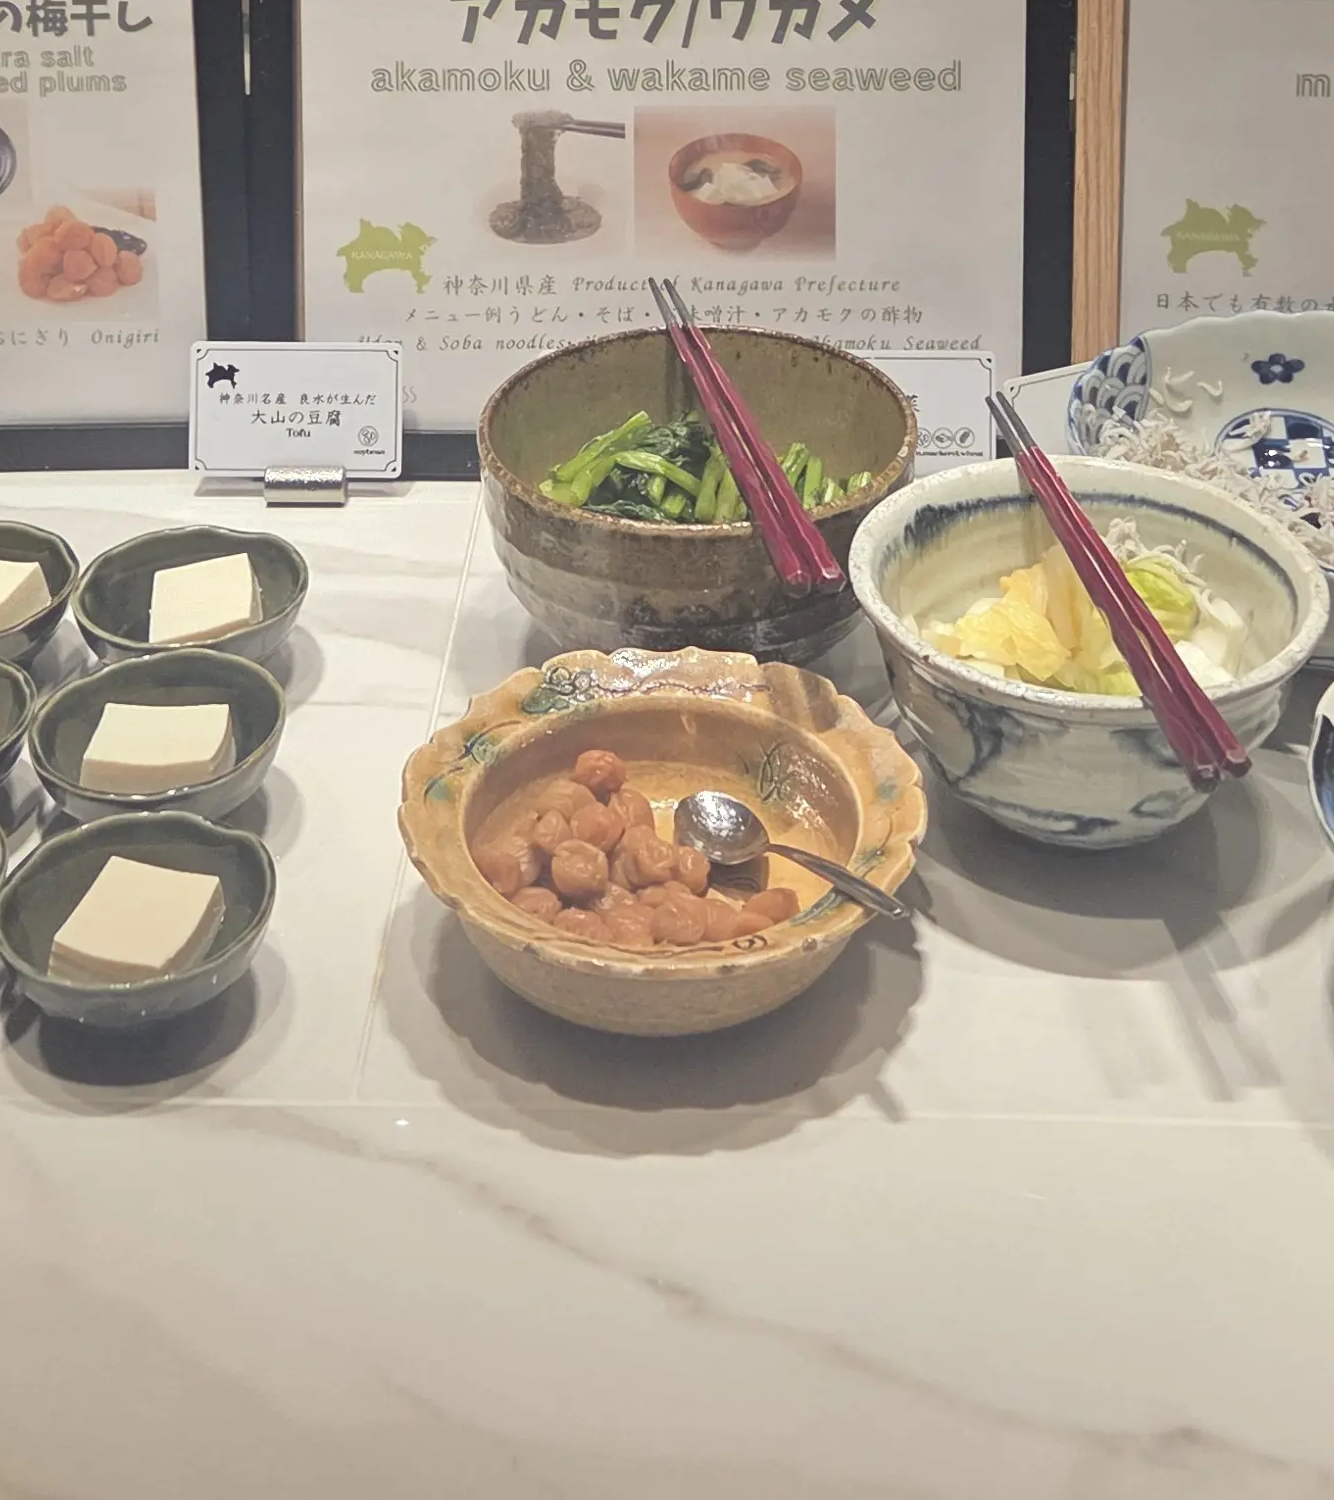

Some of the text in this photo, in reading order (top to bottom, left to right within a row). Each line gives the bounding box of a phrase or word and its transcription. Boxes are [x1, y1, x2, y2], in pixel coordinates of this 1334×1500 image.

[41, 45, 94, 68] salt
[39, 71, 127, 97] plums
[370, 59, 963, 92] akamoku & wakame seaweed
[351, 250, 413, 260] KANAGAWA
[442, 274, 557, 297] 神奈川県産
[572, 276, 648, 292] Product
[690, 276, 783, 297] Kanagawa
[794, 275, 901, 297] Prefecture
[91, 328, 160, 349] Onigiri
[416, 336, 428, 351] &
[439, 335, 483, 351] Soba
[903, 334, 983, 350] Seaweed
[219, 392, 377, 405] 神奈川名産 良水が生んだ
[251, 409, 342, 426] 大山の豆腐
[286, 428, 311, 438] Tofu
